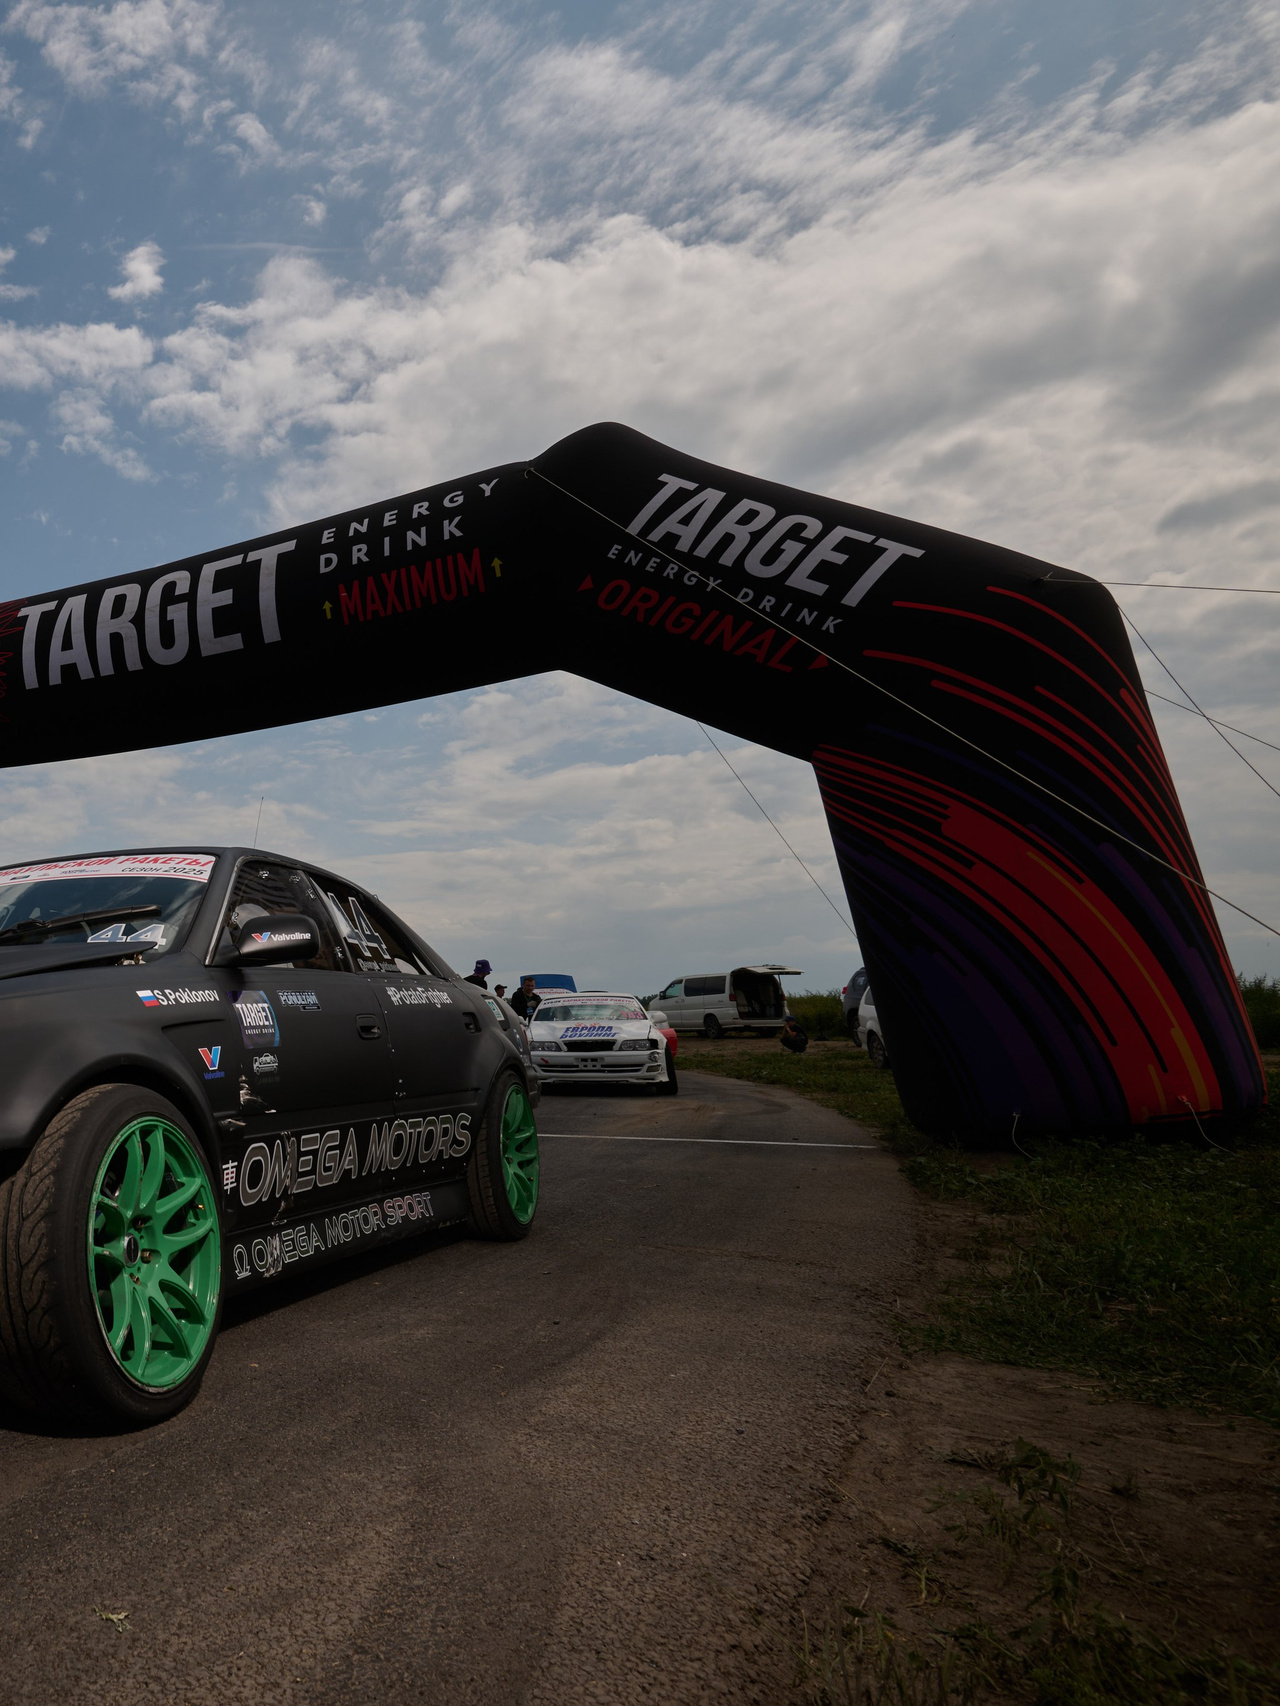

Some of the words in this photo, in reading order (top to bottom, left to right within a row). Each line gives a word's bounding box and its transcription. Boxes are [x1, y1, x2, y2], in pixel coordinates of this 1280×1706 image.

[319, 515, 464, 575] DRINK
[320, 477, 500, 545] ENERGY
[625, 472, 927, 609] TARGET
[17, 539, 297, 690] TARGET
[338, 547, 487, 626] MAXIMUM
[606, 543, 724, 593] ENERGY
[736, 587, 845, 634] DRINK
[596, 578, 800, 674] ORIGINAL
[117, 856, 215, 868] РАКЕТЫ
[162, 866, 207, 876] 2025
[87, 923, 167, 950] 44
[270, 932, 312, 942] Valvoline
[326, 891, 391, 959] 44
[153, 987, 220, 1006] S.Poklonov
[235, 1003, 274, 1027] TARGET
[385, 986, 453, 1009] #PotatoFighter
[239, 1127, 359, 1207] OMEGA
[362, 1112, 472, 1177] MOTORS
[251, 1222, 325, 1275] OMEGA
[324, 1203, 386, 1249] MOTOR
[383, 1191, 434, 1226] SPORT
